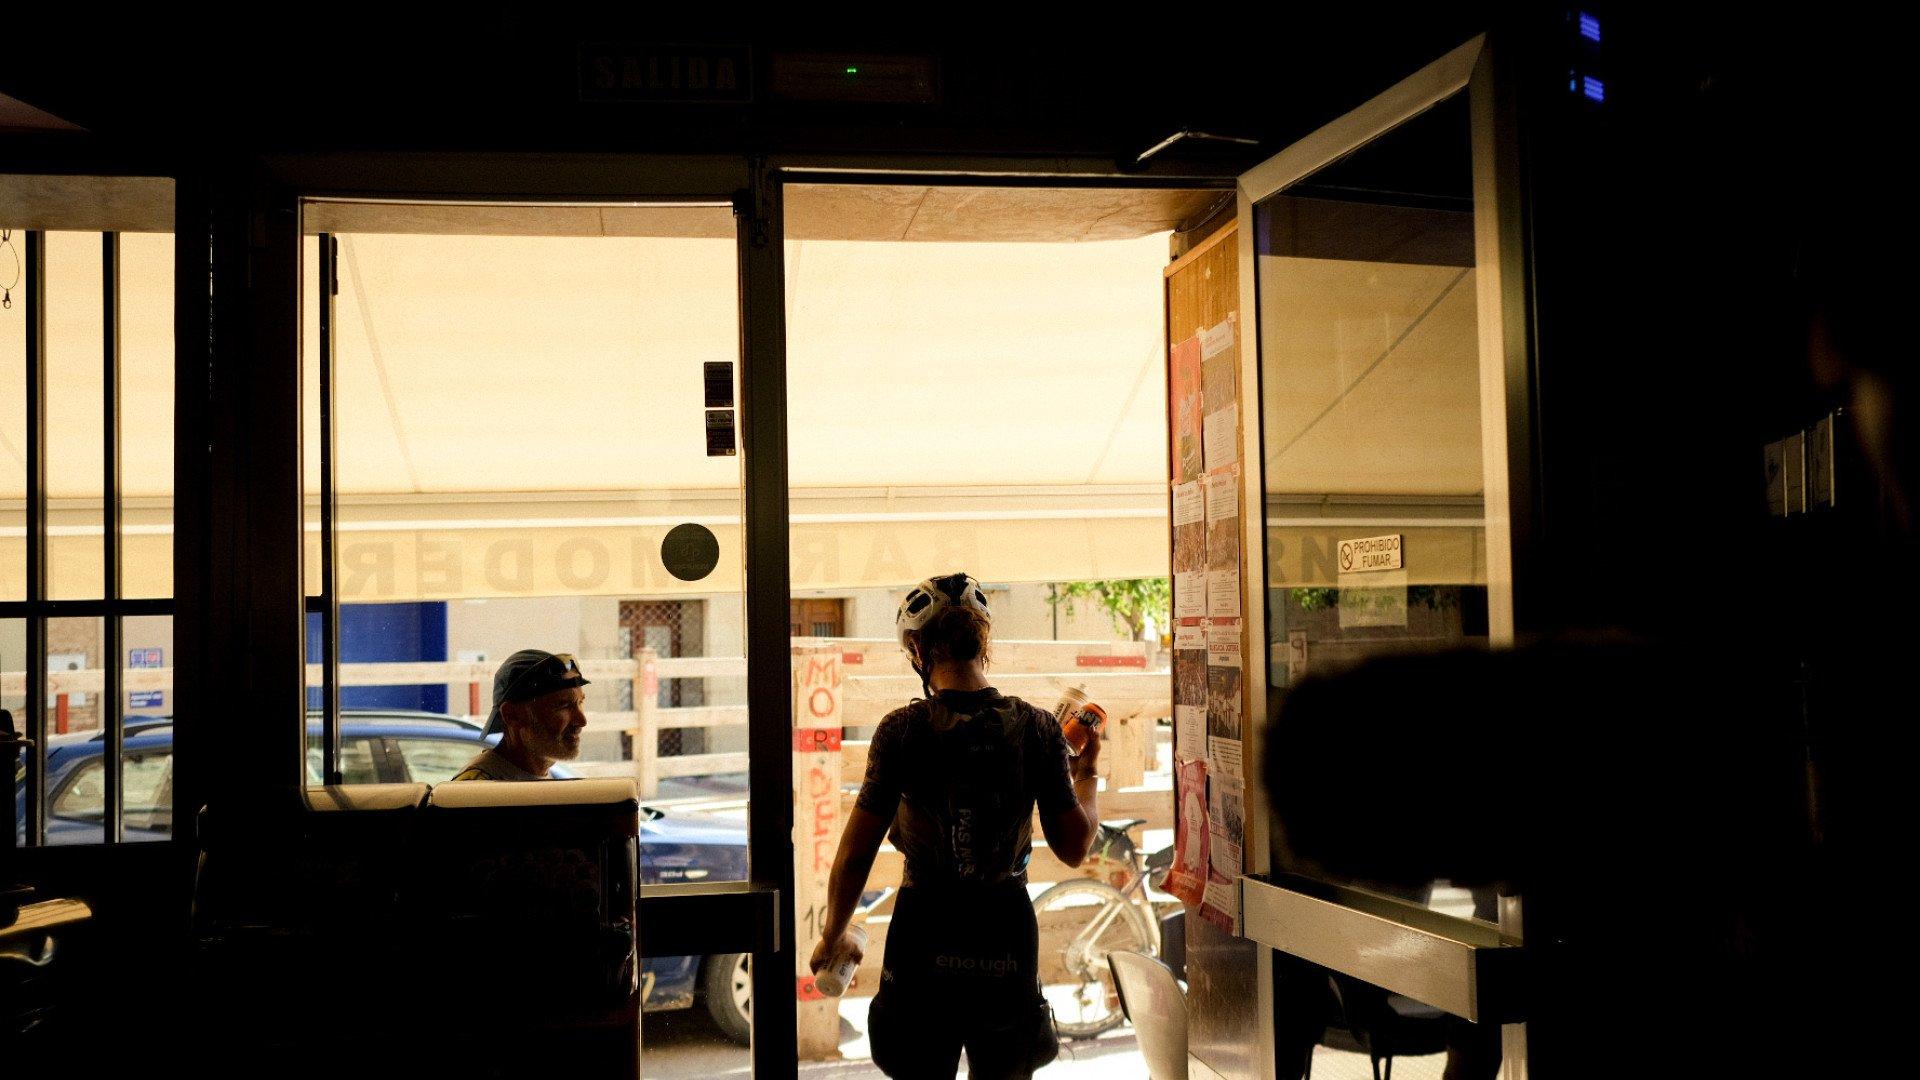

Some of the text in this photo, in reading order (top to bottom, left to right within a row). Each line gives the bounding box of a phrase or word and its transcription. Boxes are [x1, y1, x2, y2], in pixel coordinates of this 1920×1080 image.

[591, 56, 737, 89] SALIDA
[1353, 537, 1400, 554] PROHIBIDO
[1362, 553, 1391, 568] FUMAR
[935, 953, 1018, 977] enough
